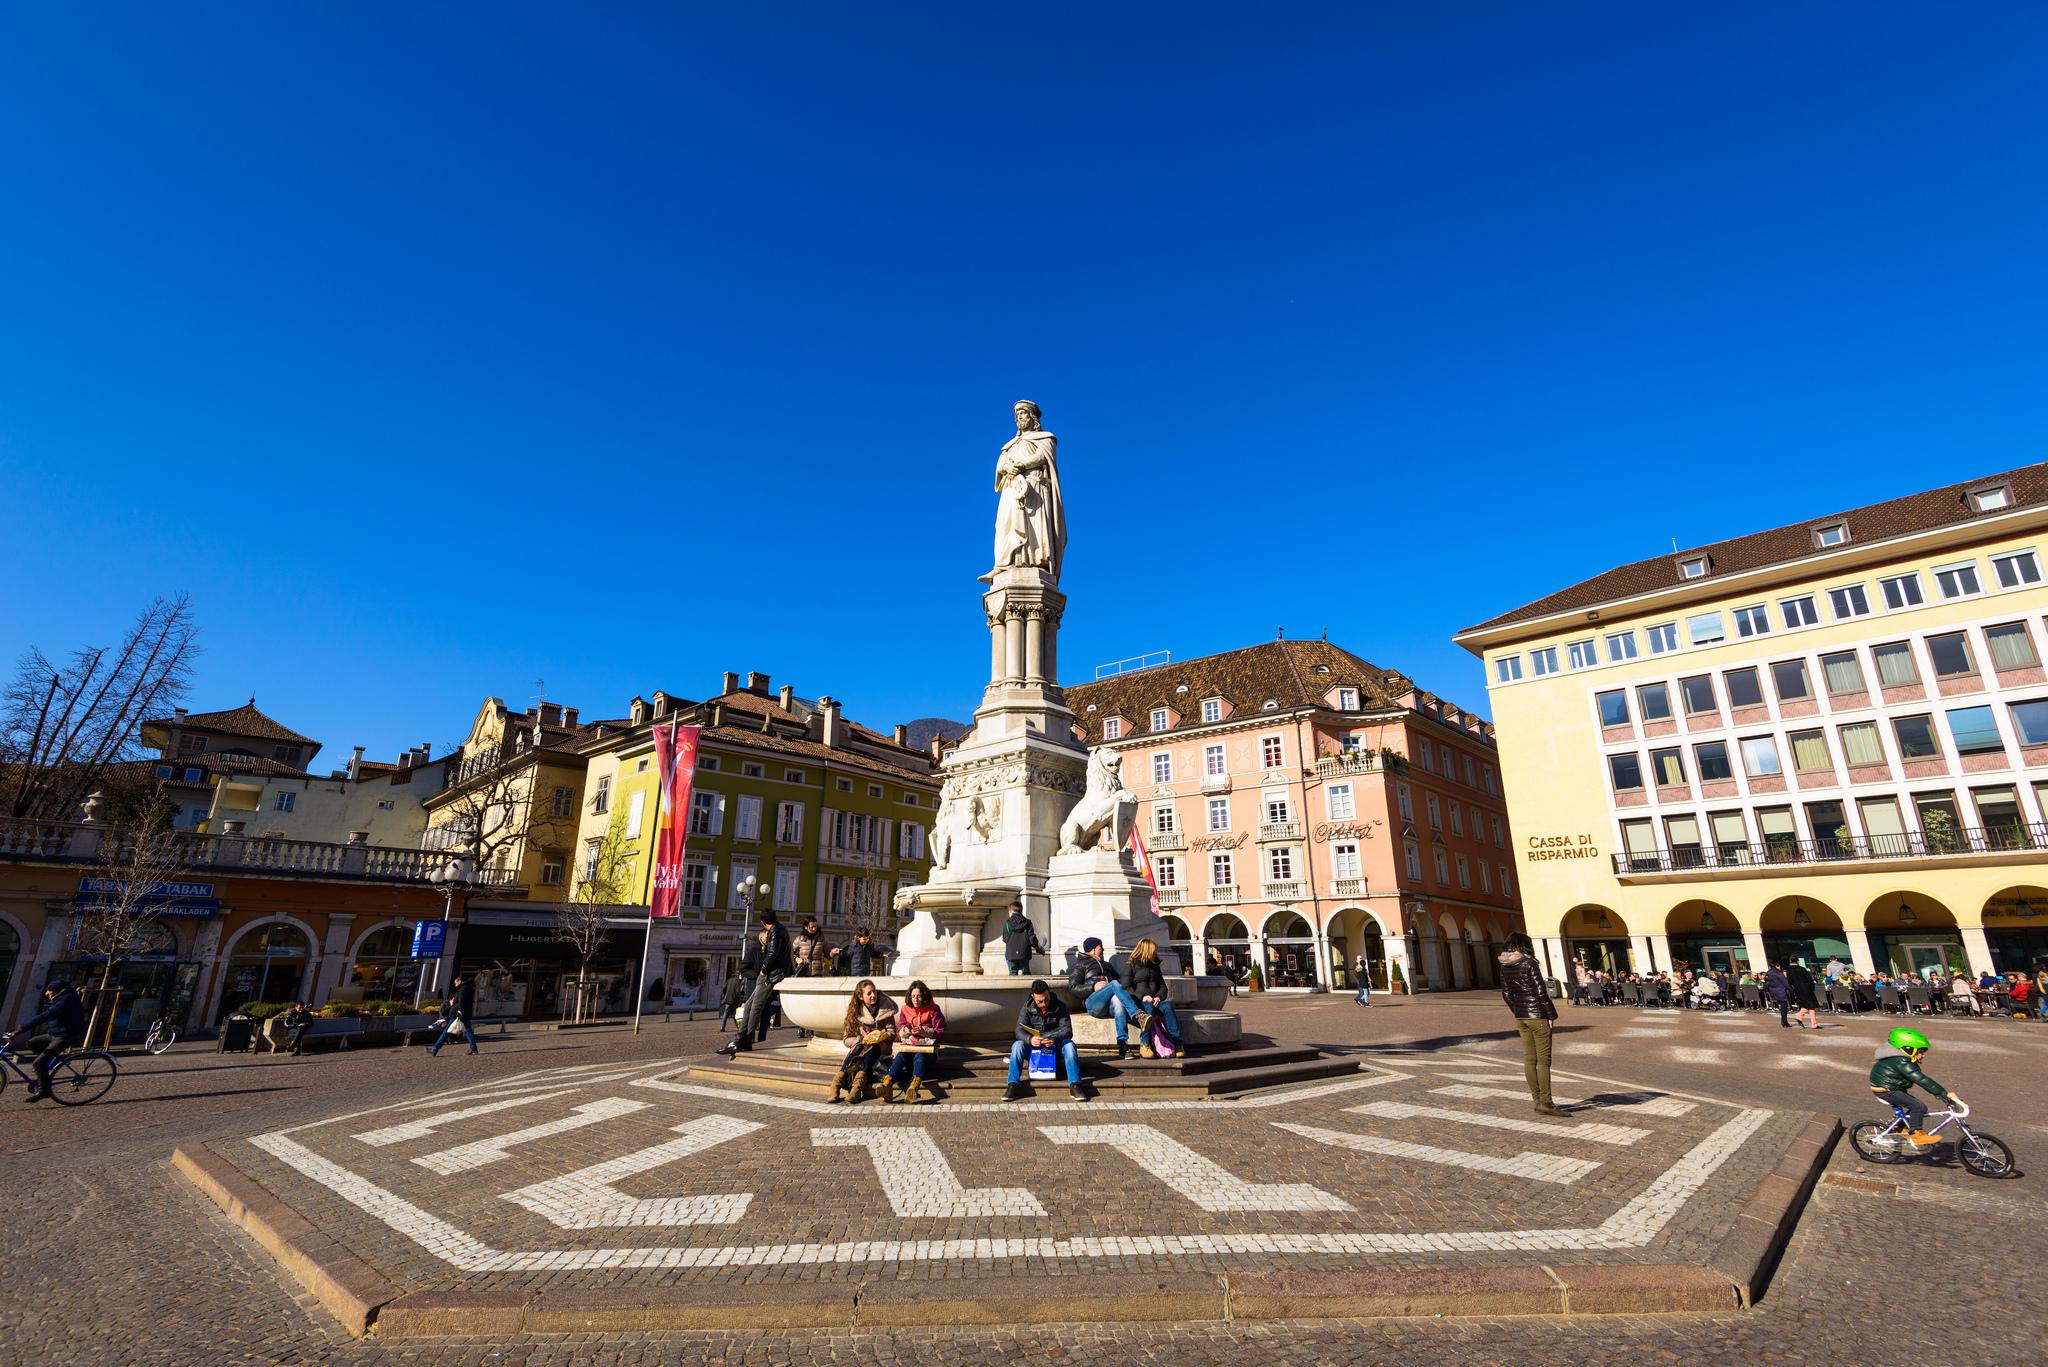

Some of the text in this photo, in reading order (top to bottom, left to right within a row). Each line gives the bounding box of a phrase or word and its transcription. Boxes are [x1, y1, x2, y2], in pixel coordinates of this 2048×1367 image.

[1529, 834, 1592, 849] CASSA DI
[1527, 847, 1598, 861] RISPARMIO
[165, 883, 208, 895] TABAK
[426, 926, 441, 940] P
[510, 935, 556, 943] HUBERT
